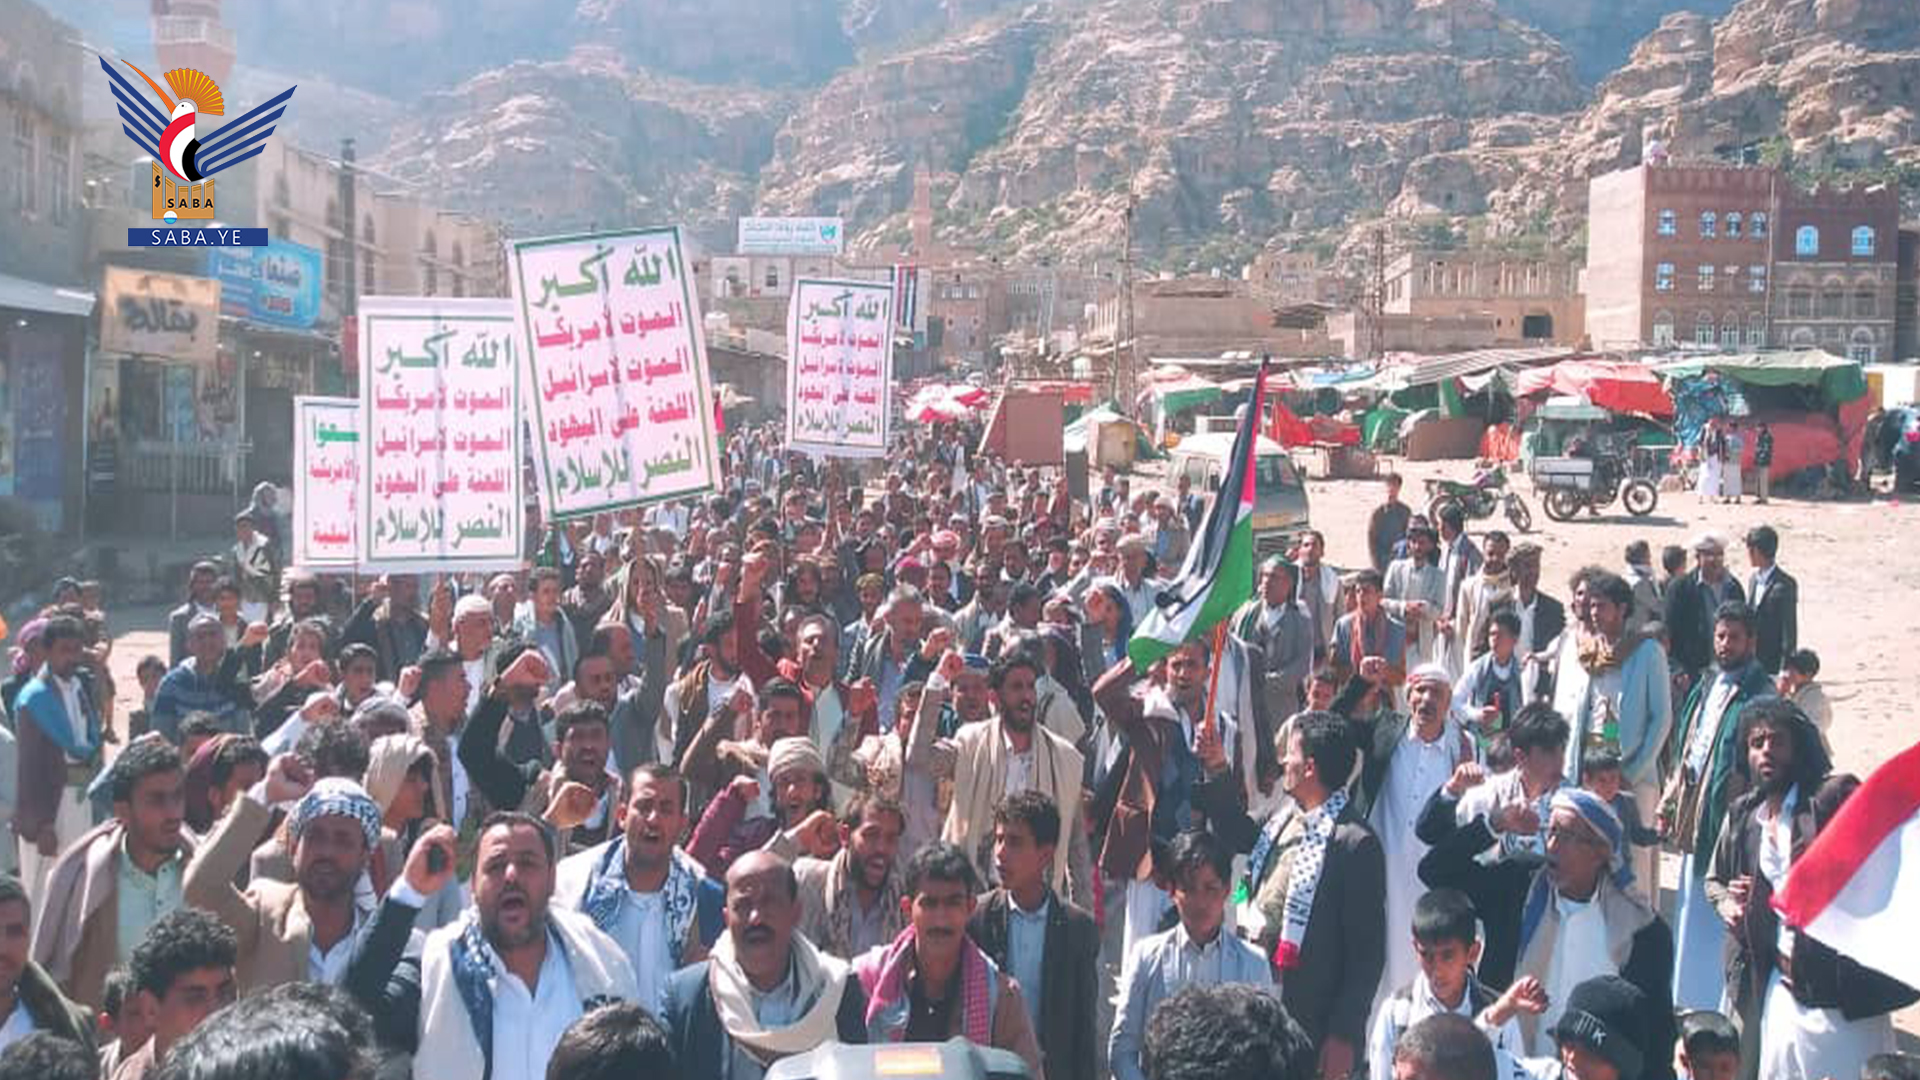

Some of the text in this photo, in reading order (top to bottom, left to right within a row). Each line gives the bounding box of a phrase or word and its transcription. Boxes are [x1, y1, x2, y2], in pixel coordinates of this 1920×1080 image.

[624, 244, 676, 285] الله
[619, 301, 682, 338] الموت
[462, 331, 511, 368] الله
[627, 346, 689, 385] الموت
[454, 386, 511, 415] الموت
[648, 391, 695, 423] اللعنة
[454, 426, 511, 457] الموت
[548, 407, 603, 447] اليهود
[639, 433, 701, 489] النصر
[375, 467, 425, 499] اليهود
[467, 467, 511, 493] اللعنة
[451, 502, 511, 549] النصر
